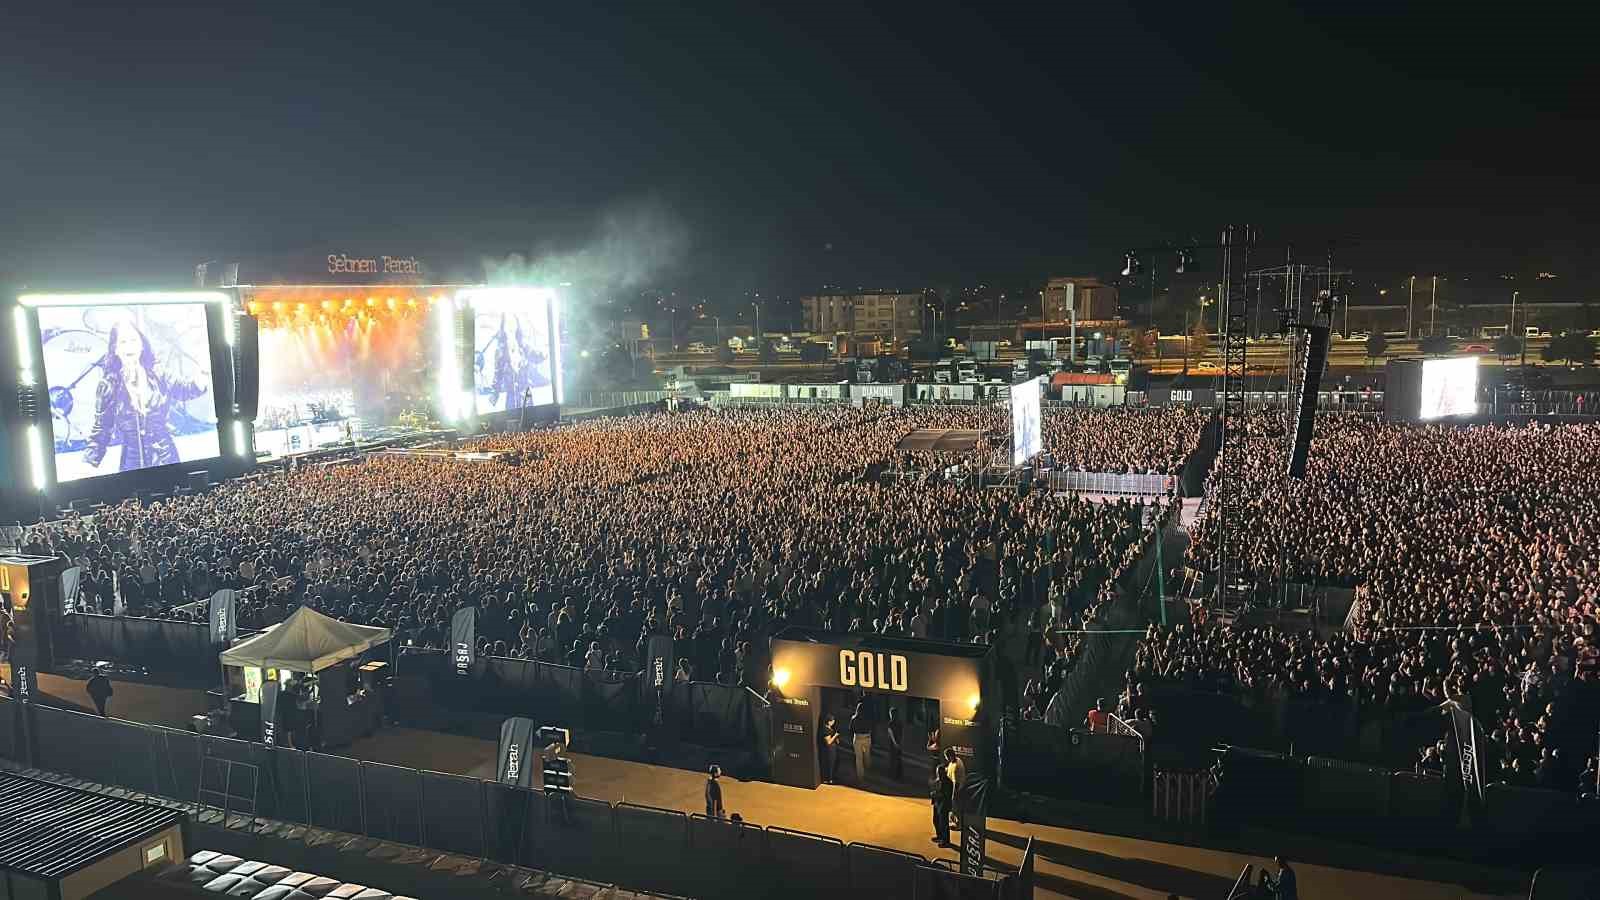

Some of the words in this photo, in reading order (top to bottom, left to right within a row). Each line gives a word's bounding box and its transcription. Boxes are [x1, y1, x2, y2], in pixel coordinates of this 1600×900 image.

[862, 386, 893, 397] DIAMOND
[1170, 390, 1193, 401] GOLD
[839, 649, 909, 692] GOLD
